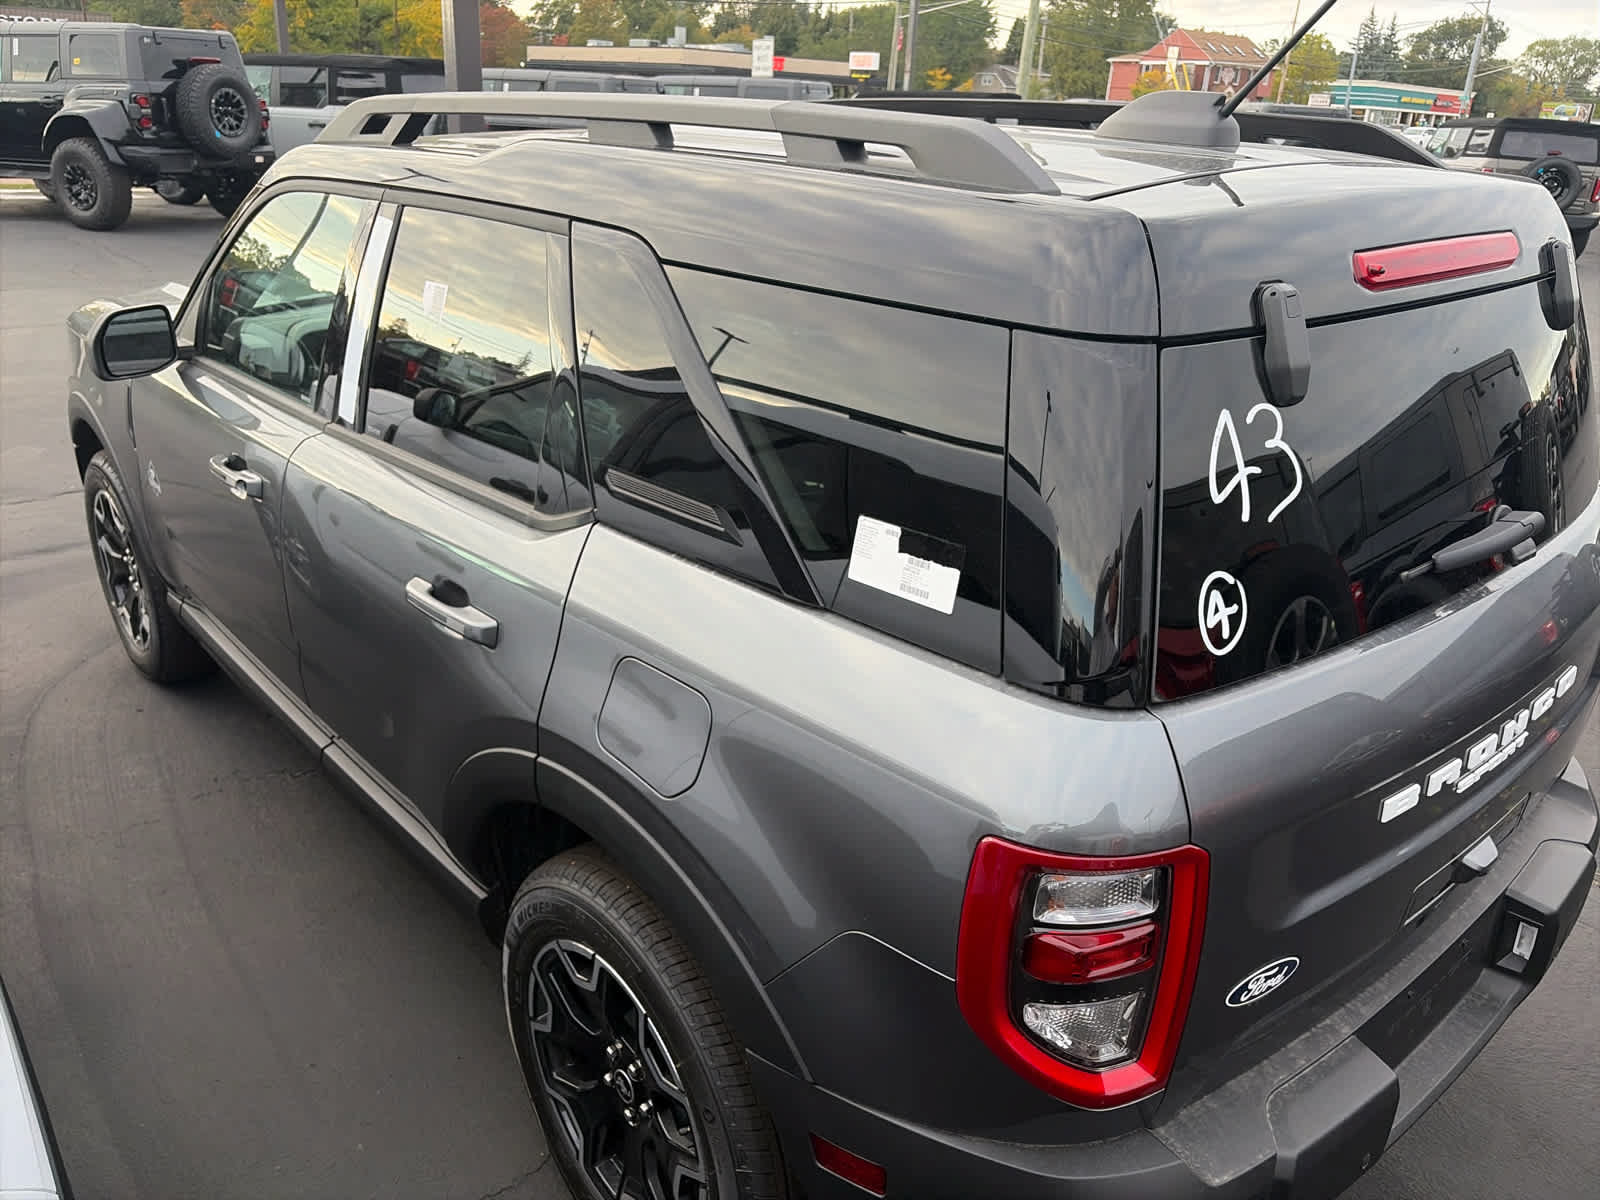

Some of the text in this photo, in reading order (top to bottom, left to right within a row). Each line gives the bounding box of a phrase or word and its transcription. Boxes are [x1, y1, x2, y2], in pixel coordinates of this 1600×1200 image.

[0, 14, 69, 23] STO
[1209, 403, 1303, 522] 43
[1378, 665, 1578, 824] BRONCO
[1240, 965, 1289, 1002] Ford
